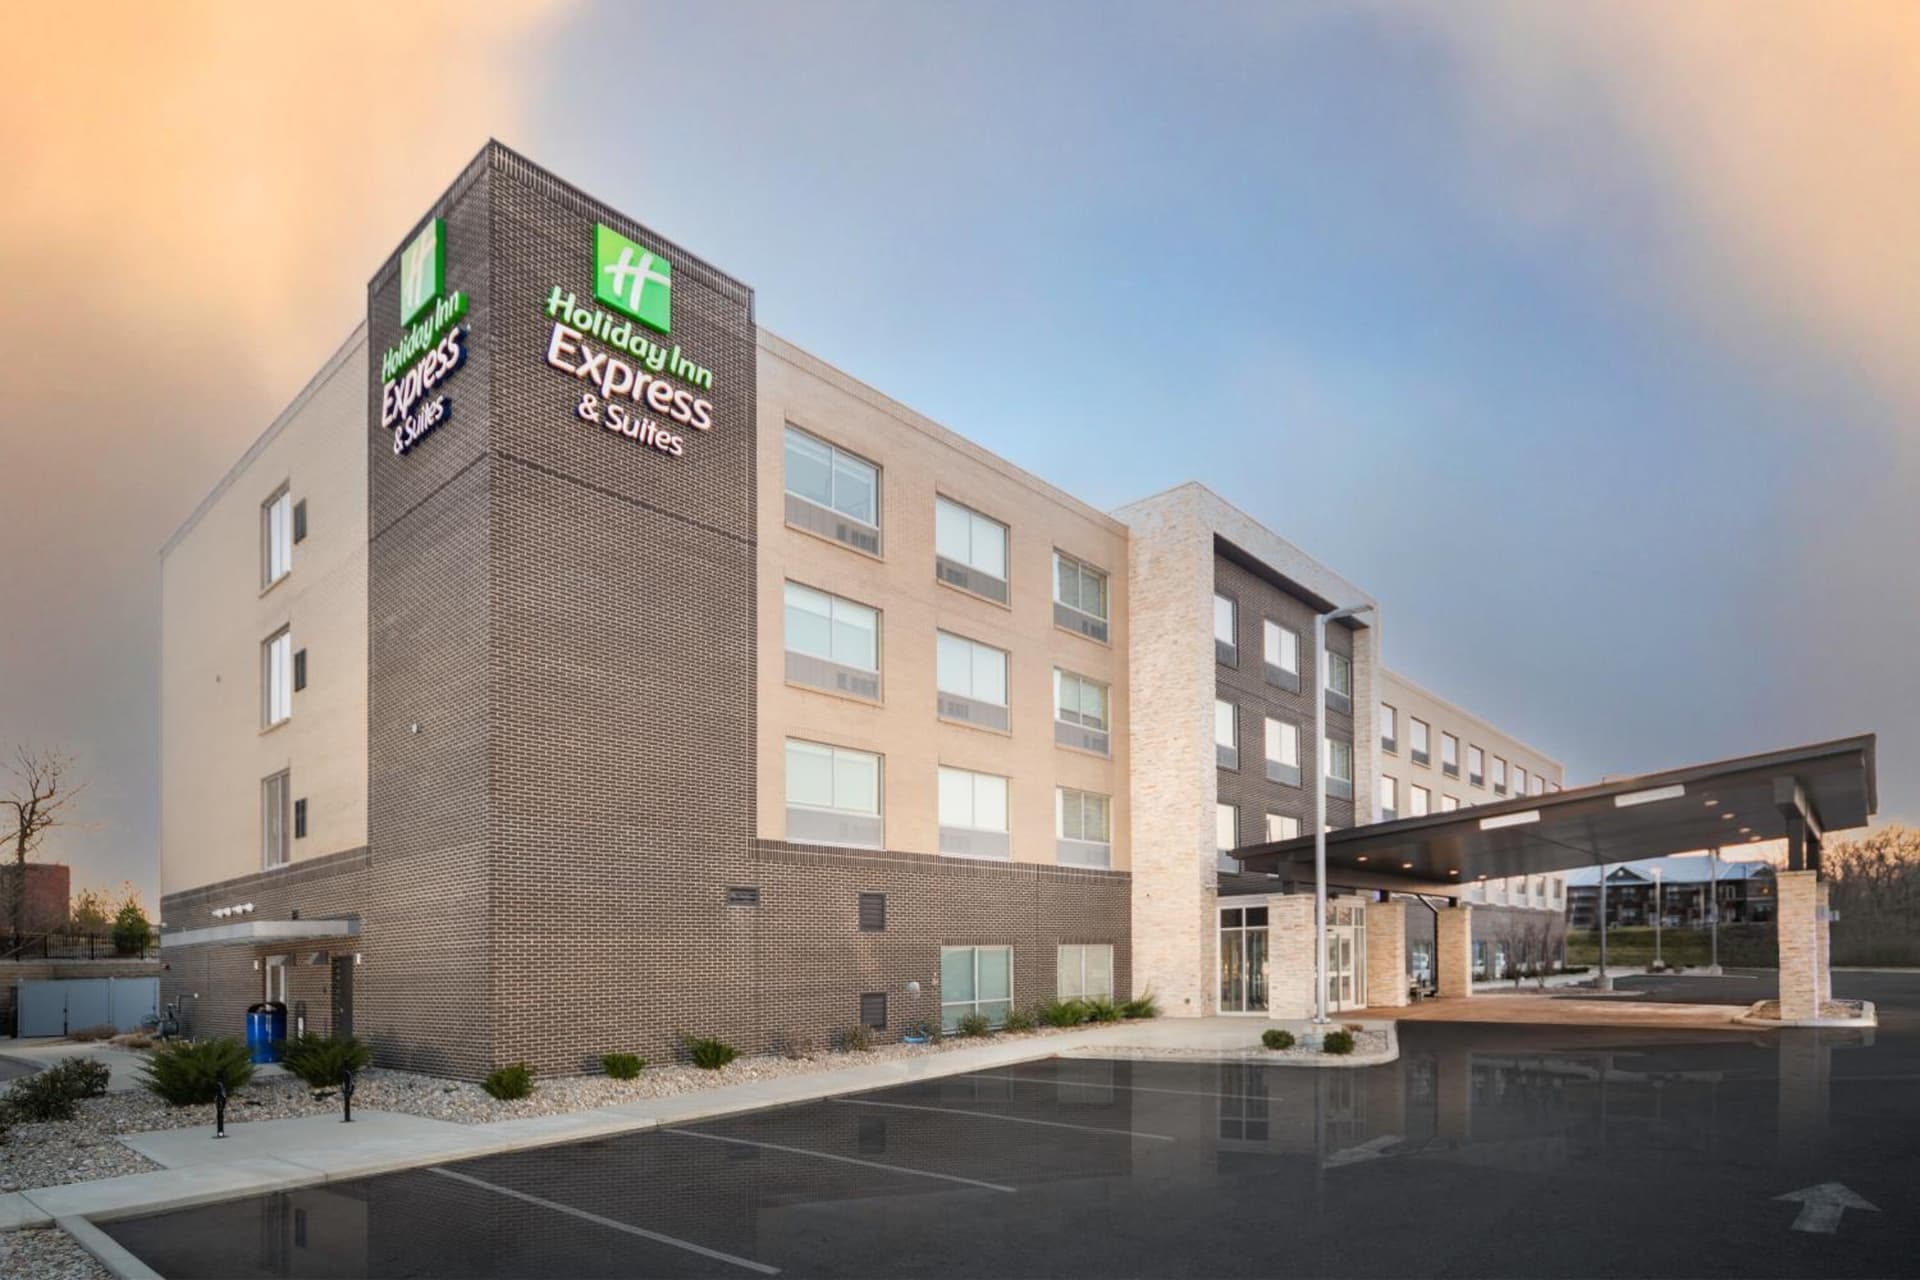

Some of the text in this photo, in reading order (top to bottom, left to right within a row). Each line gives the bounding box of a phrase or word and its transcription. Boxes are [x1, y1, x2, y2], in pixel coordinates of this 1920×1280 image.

[382, 291, 460, 377] Holiday Inn
[382, 328, 460, 428] Express
[547, 286, 713, 389] Holiday Inn
[547, 323, 713, 431] Express
[394, 395, 444, 454] & Suites
[578, 393, 684, 456] & Suites
